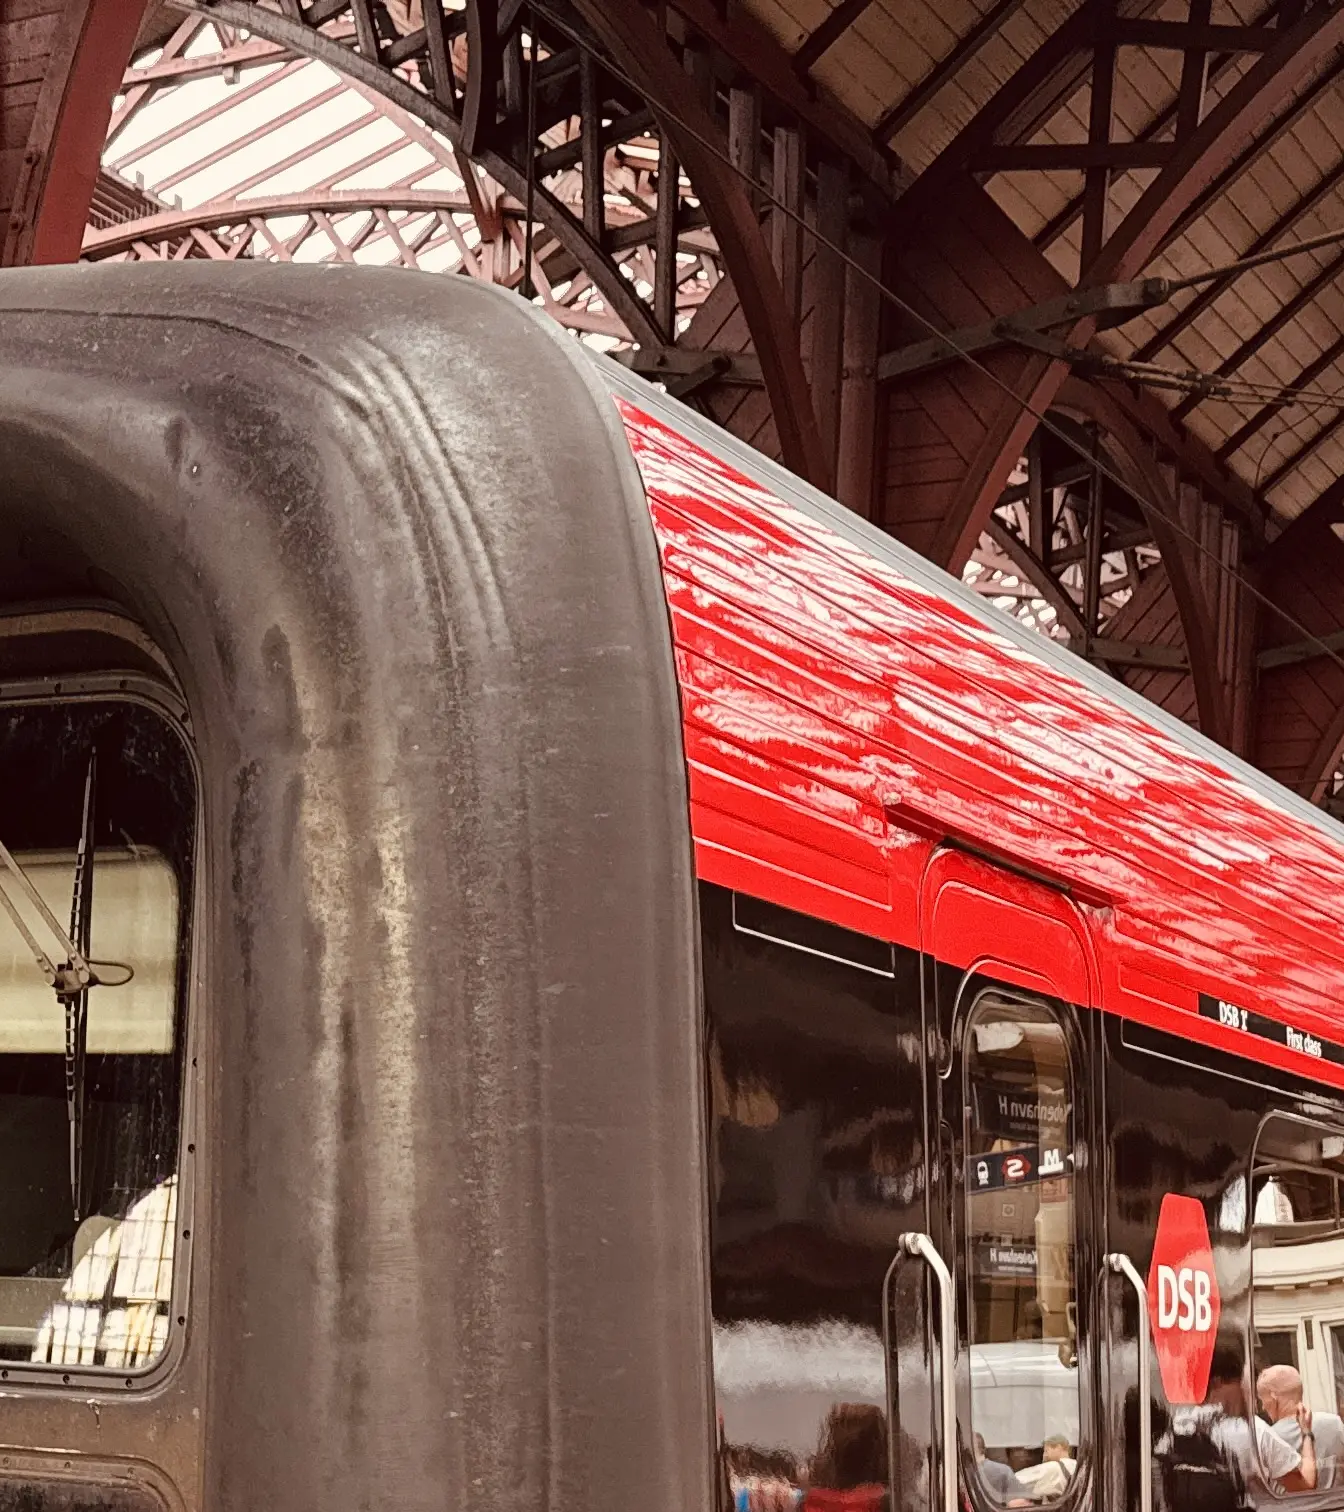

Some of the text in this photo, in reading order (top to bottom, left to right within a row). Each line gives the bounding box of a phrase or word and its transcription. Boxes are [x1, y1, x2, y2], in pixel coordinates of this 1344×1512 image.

[1218, 1000, 1240, 1027] DSB
[1285, 1025, 1323, 1058] First class
[1157, 1264, 1212, 1332] DSB
